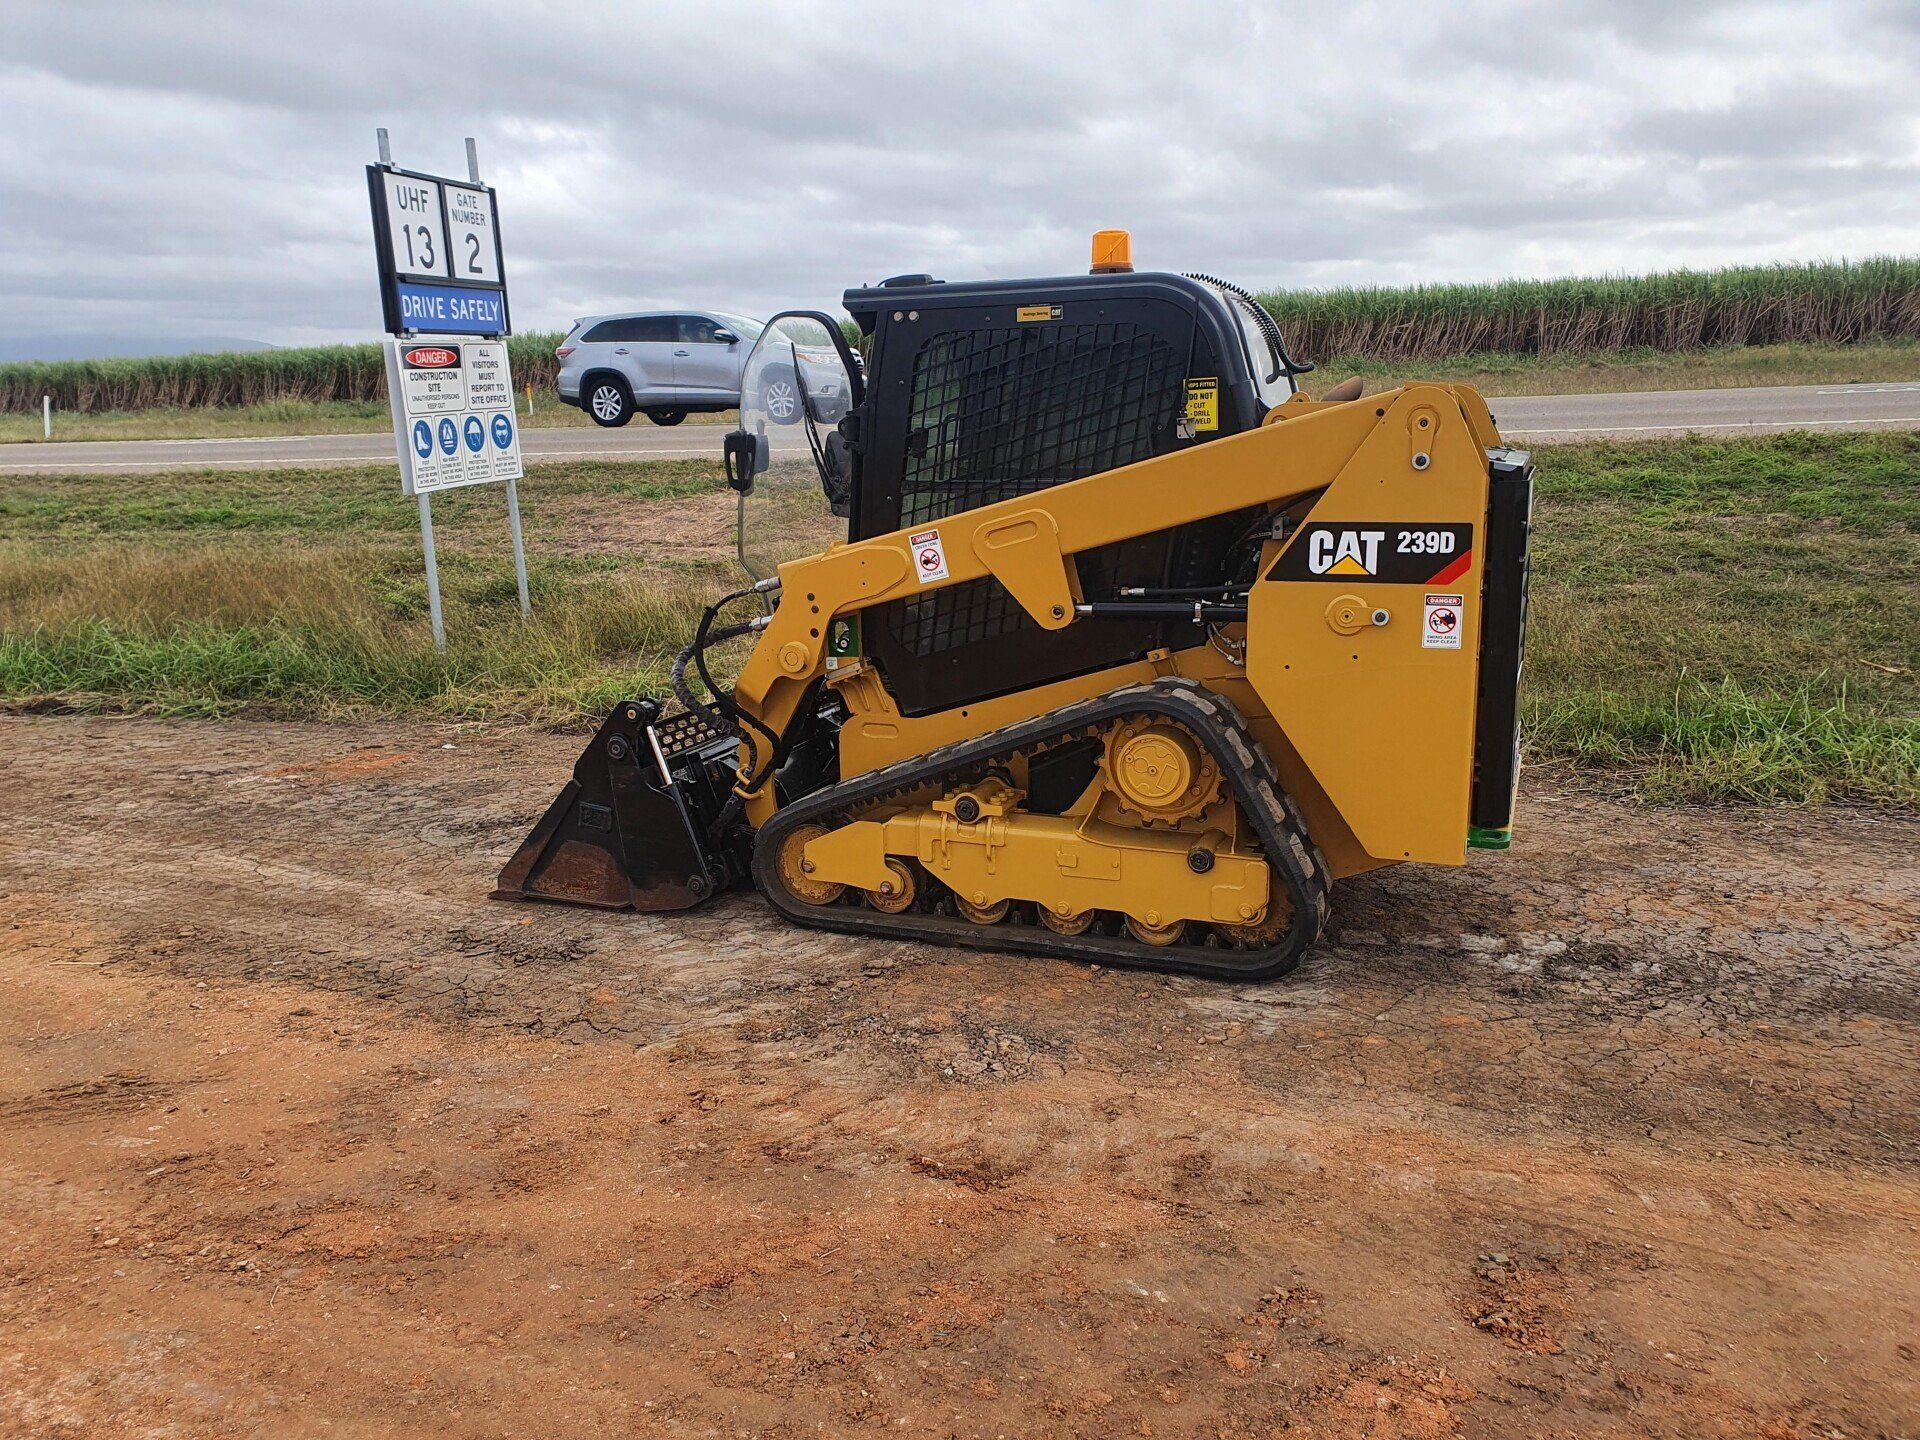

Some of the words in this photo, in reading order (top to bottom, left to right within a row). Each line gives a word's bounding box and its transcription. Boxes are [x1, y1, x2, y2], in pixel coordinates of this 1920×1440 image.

[396, 185, 428, 212] UHF
[456, 193, 478, 209] GATE
[452, 209, 486, 226] NUMBER
[403, 224, 435, 269] 13
[465, 233, 483, 274] 2
[402, 294, 446, 319] DRIVE
[450, 299, 499, 321] SAFELY
[415, 351, 448, 363] DANGER
[478, 349, 490, 357] ALL
[471, 361, 499, 369] VISITORS
[409, 371, 458, 381] CONSTRUCTION
[478, 372, 495, 381] MUST
[427, 383, 442, 392] SITE
[471, 384, 496, 392] REPORT
[496, 383, 505, 391] TO
[471, 396, 484, 404] SITE
[485, 394, 508, 404] OFFICE
[1200, 392, 1214, 400] NOT
[1308, 529, 1386, 576] CAT
[1396, 531, 1456, 554] 239D
